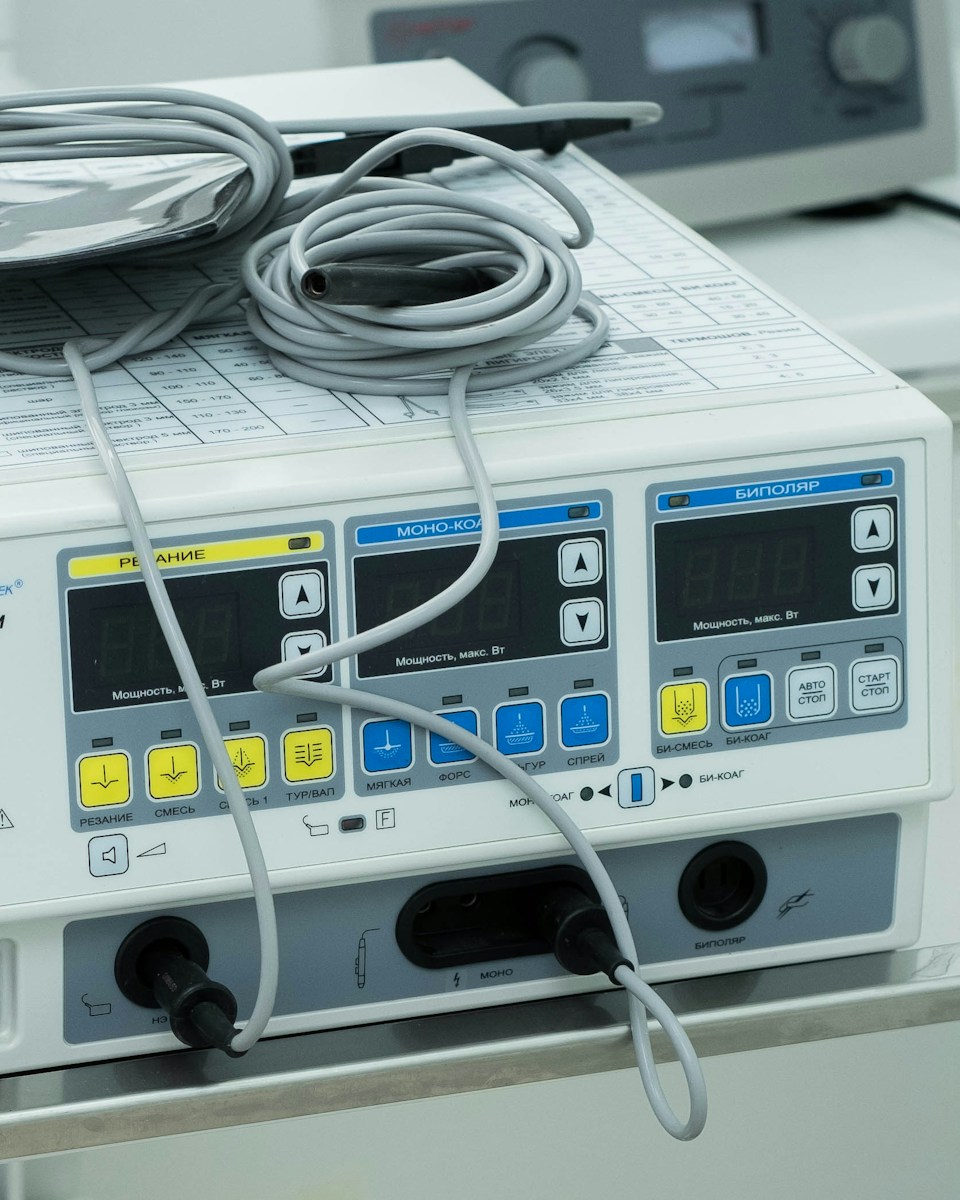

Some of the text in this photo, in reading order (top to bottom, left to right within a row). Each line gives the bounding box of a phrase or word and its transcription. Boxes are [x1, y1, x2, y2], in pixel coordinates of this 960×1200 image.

[736, 481, 820, 499] БИПОЛЯР
[120, 549, 206, 568] РЕАНИЕ
[693, 610, 799, 631] Мощность, макс. Вт
[395, 645, 505, 667] Мощность, макс. Вт
[858, 672, 891, 684] СТАРТ
[112, 687, 176, 701] Мощность,
[211, 679, 226, 689] Вт
[798, 680, 826, 692] АВТО
[861, 686, 890, 697] СТОП
[798, 693, 826, 705] СТОП
[726, 731, 771, 745] БИ-КОАГ
[656, 740, 713, 754] БИ-СМЕСЬ
[567, 753, 606, 767] СПРЕЙ
[438, 770, 472, 782] ФОРС
[699, 769, 745, 783] БИ-КОАГ
[366, 777, 412, 792] МЯГКАЯ
[285, 787, 335, 802] ТУР/ВАП
[219, 795, 268, 810] ССЬ 1
[154, 806, 195, 818] СМЕСЬ
[79, 812, 134, 828] РЕЗАНИЕ
[694, 936, 746, 950] БИПОЛЯР
[480, 968, 514, 980] МОНО
